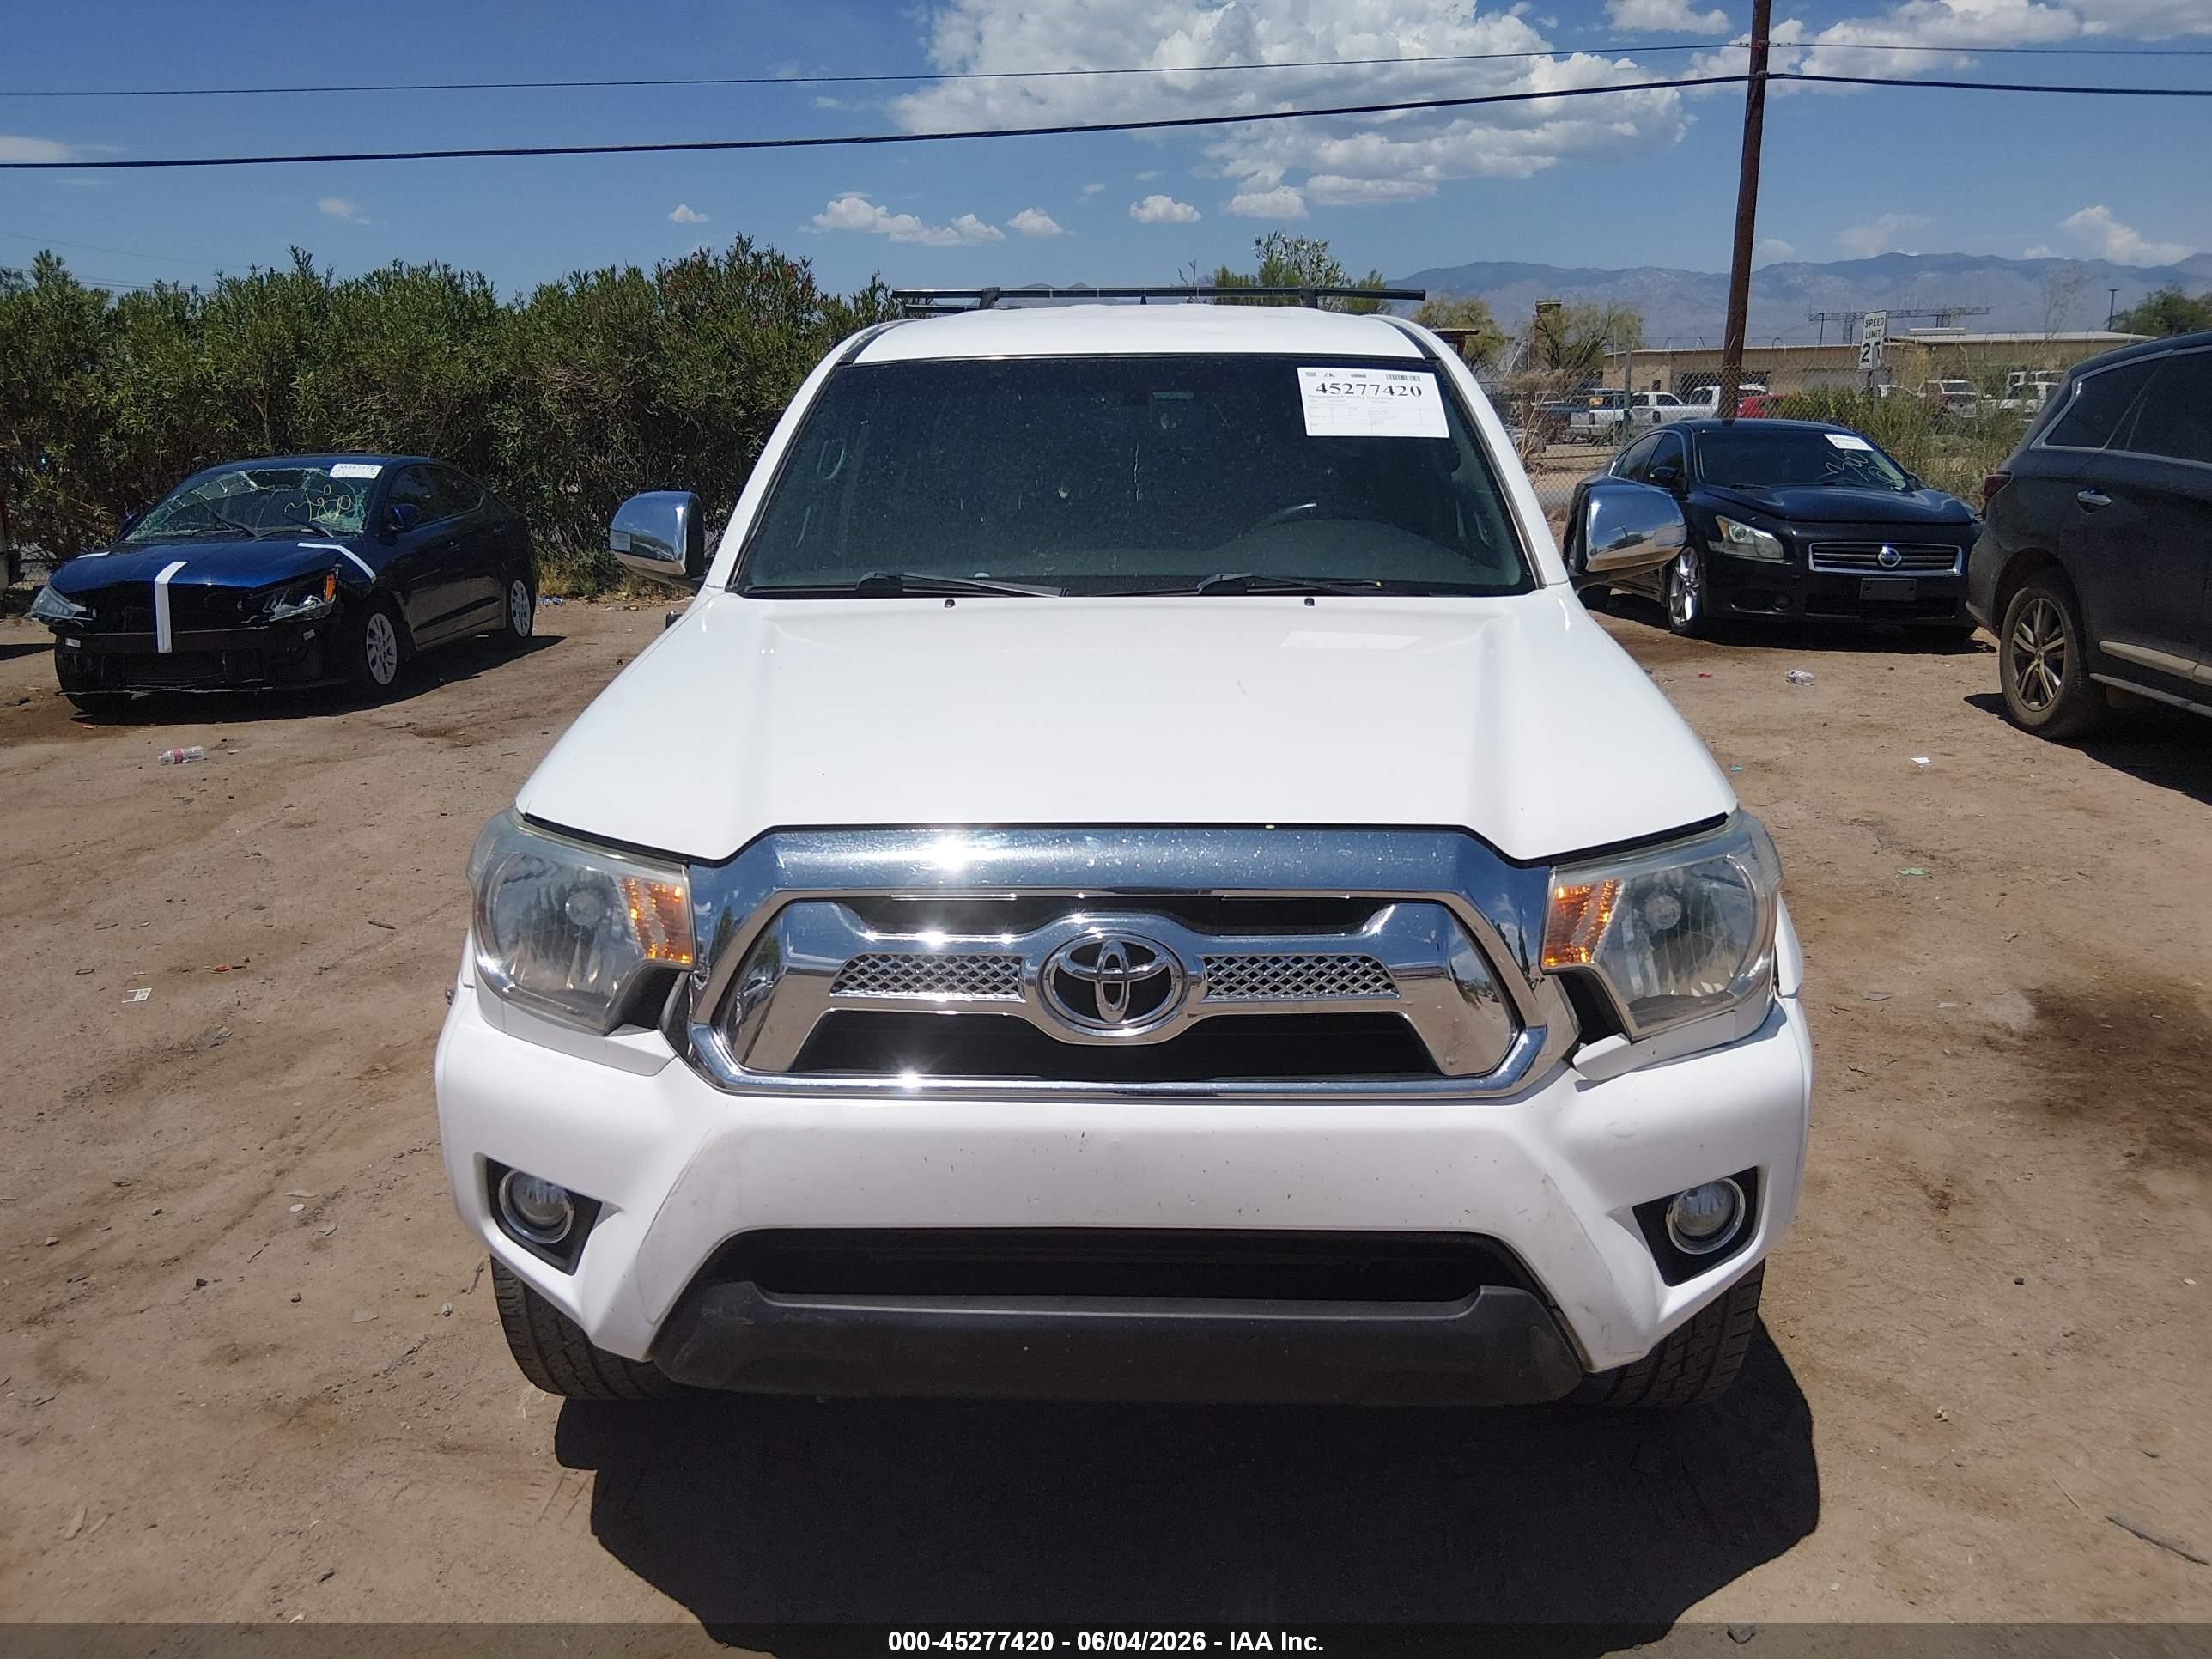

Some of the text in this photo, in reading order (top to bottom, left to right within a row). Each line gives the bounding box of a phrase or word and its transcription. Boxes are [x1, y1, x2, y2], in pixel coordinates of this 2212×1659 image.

[1864, 318, 1884, 328] SPEED
[1865, 329, 1881, 339] LIMIT
[1316, 382, 1422, 398] 45277420
